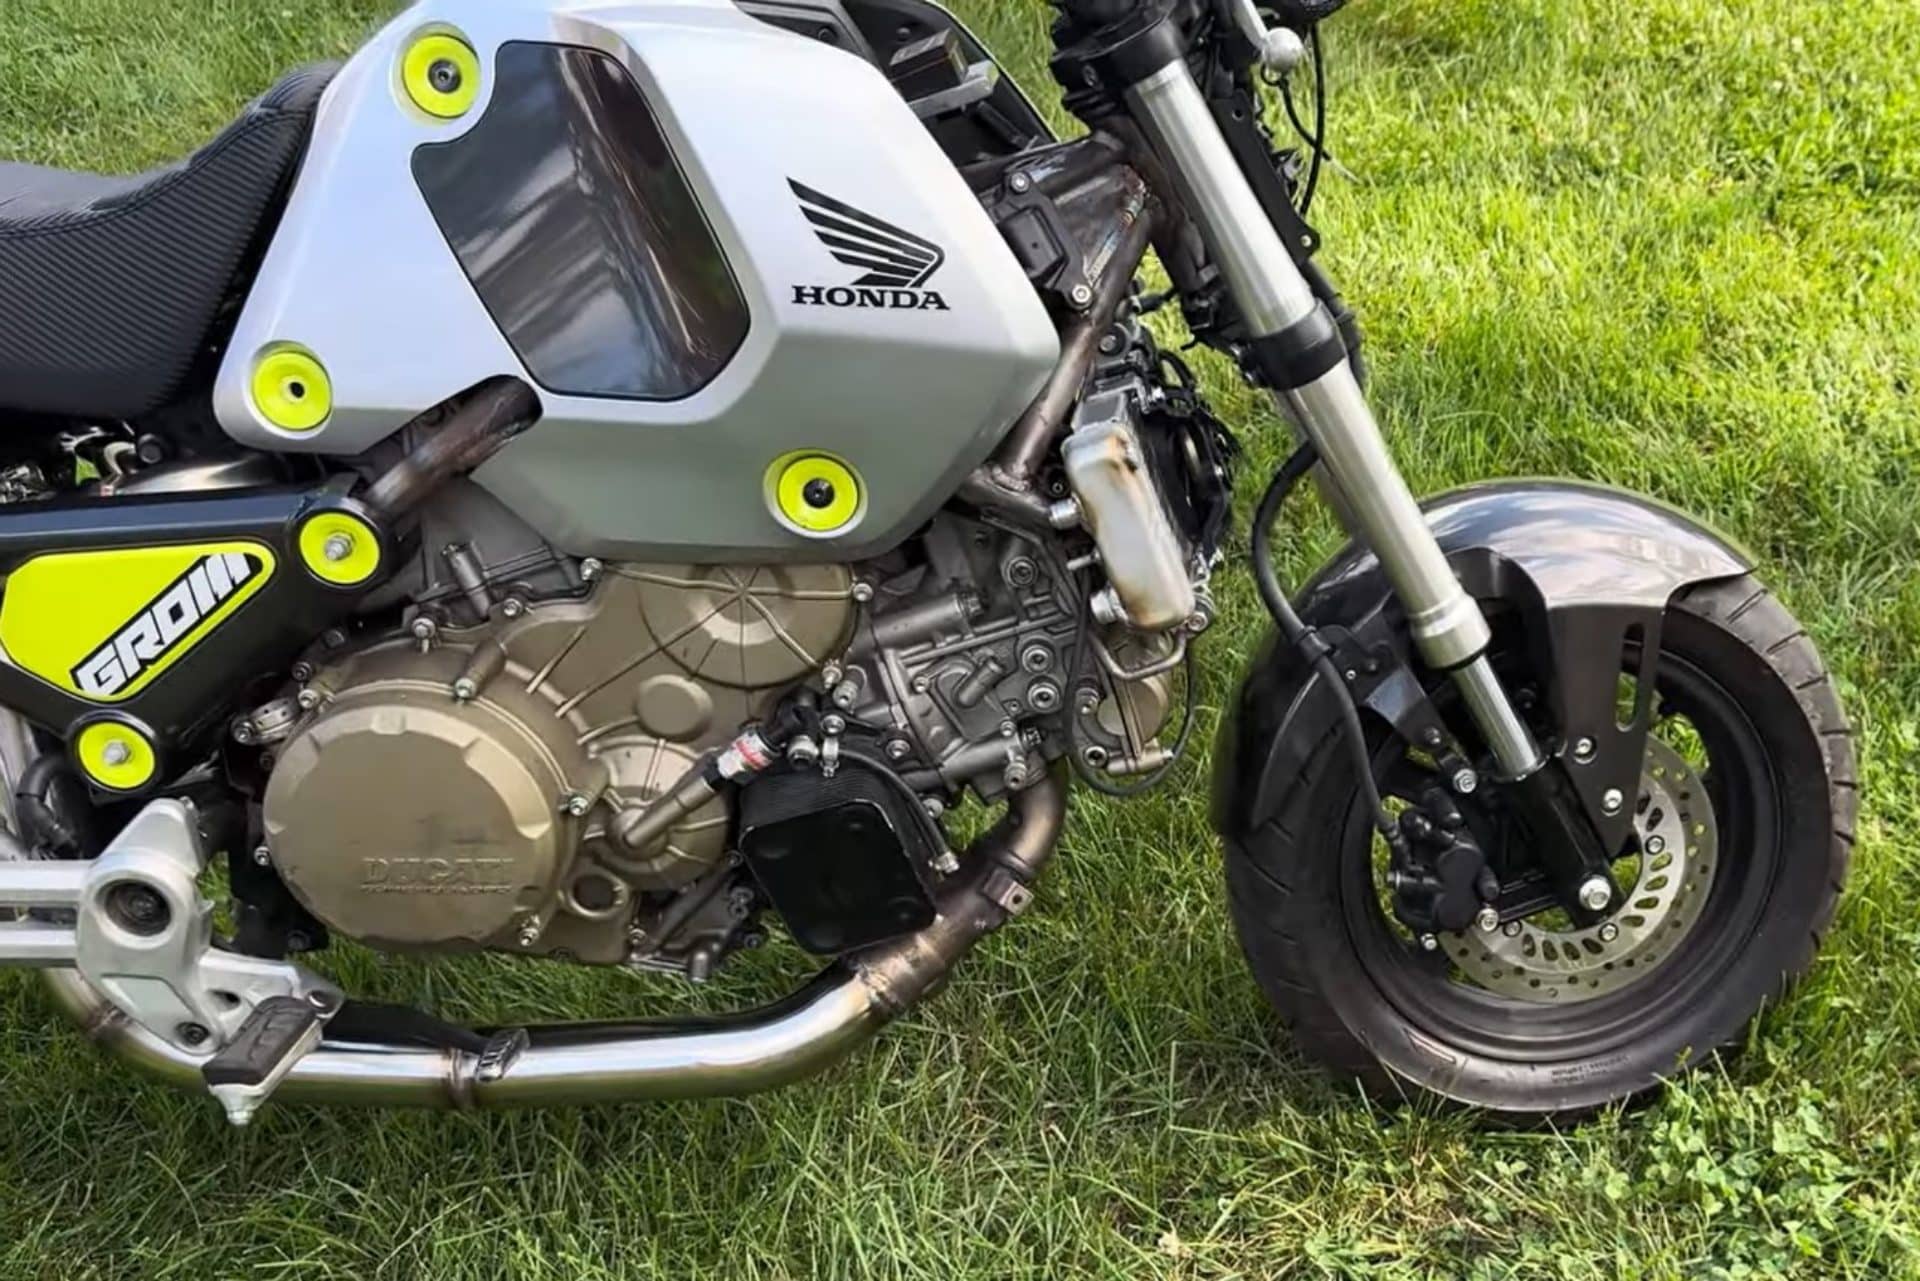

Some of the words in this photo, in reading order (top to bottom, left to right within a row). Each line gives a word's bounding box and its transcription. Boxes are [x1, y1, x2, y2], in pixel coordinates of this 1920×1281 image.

[791, 285, 950, 311] HONDA
[74, 552, 252, 696] GROM
[361, 857, 514, 886] DUCATI
